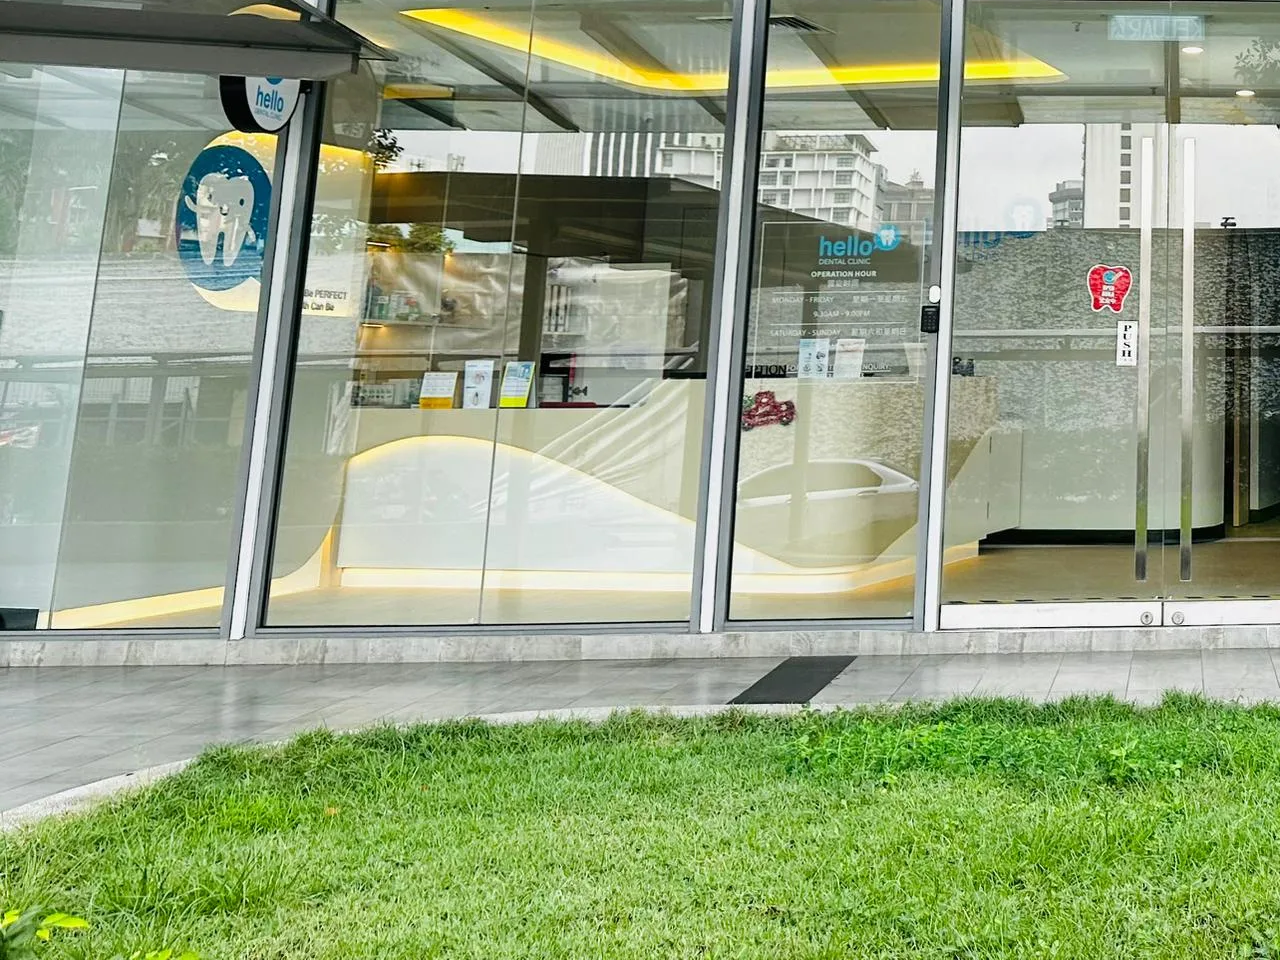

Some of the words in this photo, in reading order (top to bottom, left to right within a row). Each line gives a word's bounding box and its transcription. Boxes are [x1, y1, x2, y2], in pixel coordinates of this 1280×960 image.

[255, 84, 285, 113] hello
[819, 235, 874, 256] hello
[810, 270, 854, 278] OPERATION
[314, 289, 348, 300] PERFECT
[1120, 325, 1132, 358] PUSH
[745, 364, 787, 376] PTION
